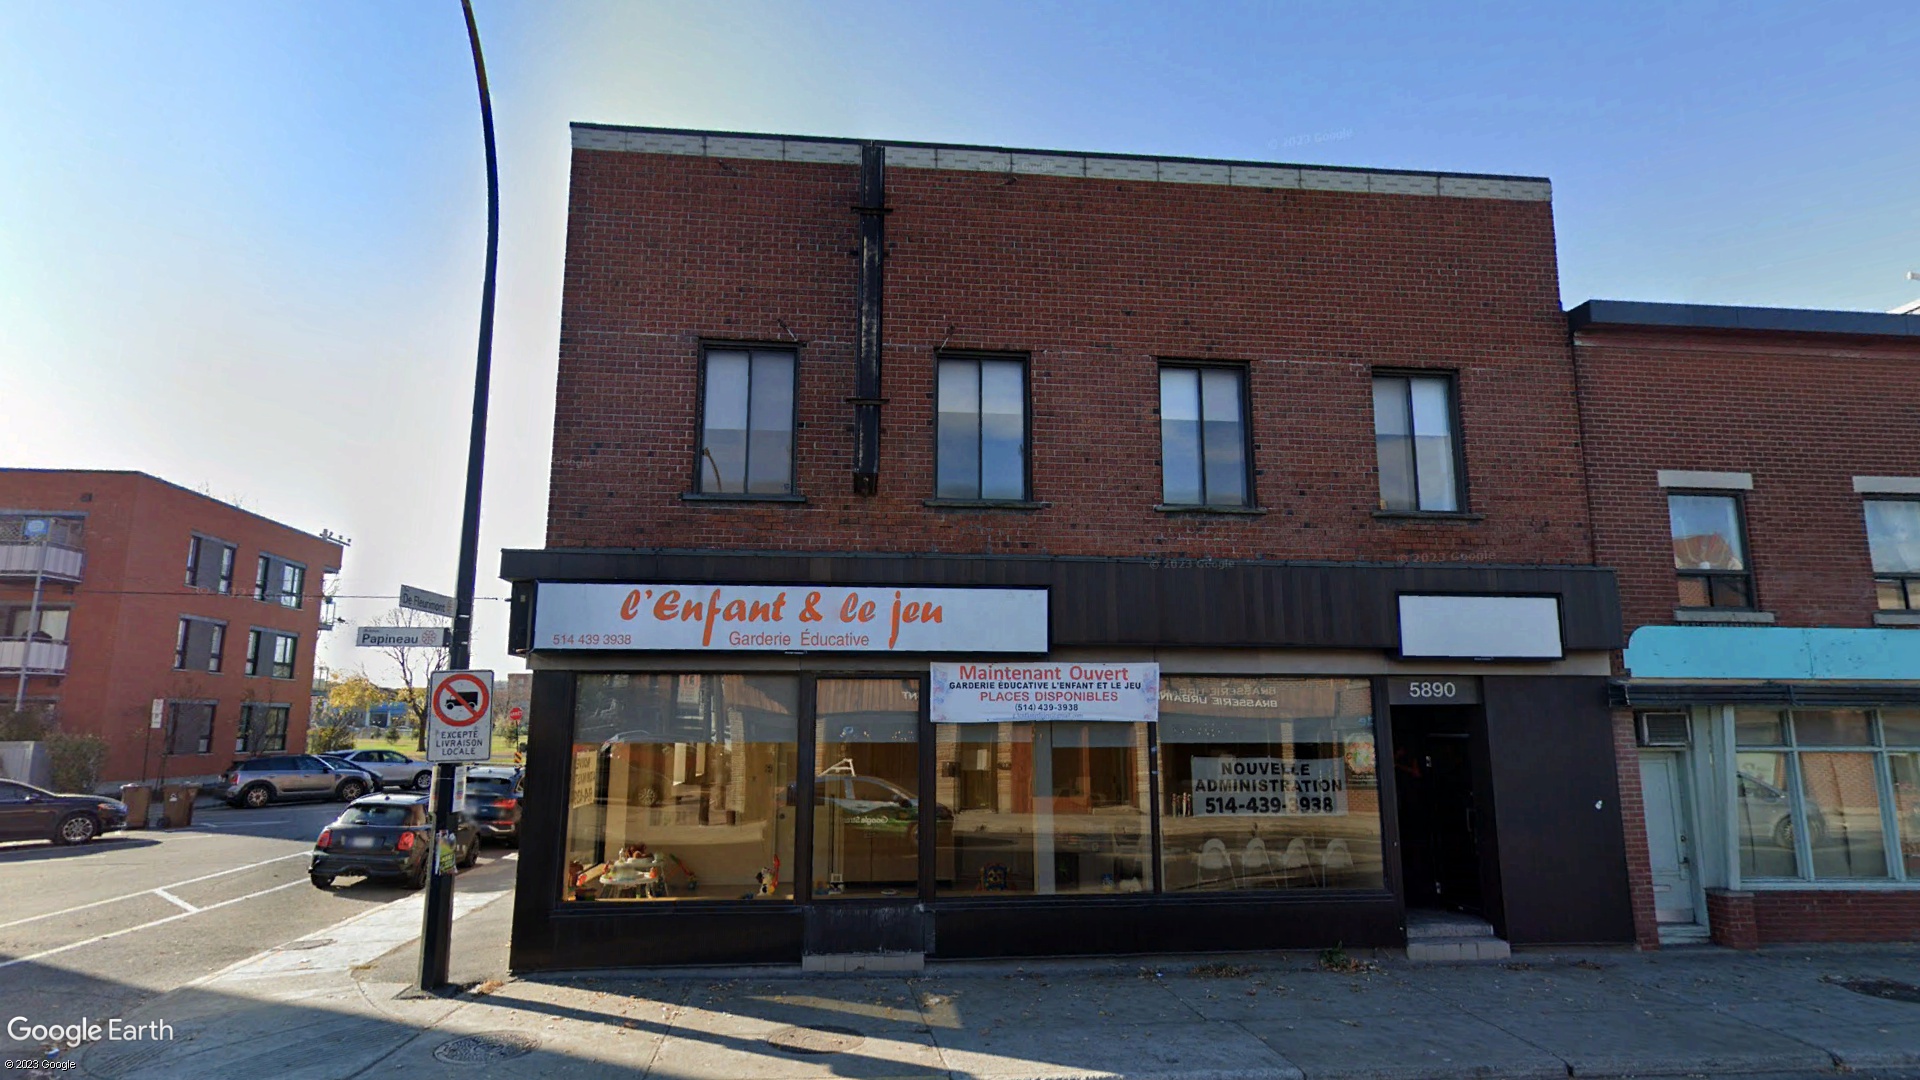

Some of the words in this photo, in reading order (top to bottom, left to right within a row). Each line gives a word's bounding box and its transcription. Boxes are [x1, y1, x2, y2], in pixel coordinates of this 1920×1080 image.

[402, 593, 412, 605] De
[798, 591, 823, 622] &
[839, 592, 876, 623] le
[888, 589, 943, 650] jeu
[361, 633, 419, 646] Papineau
[552, 634, 574, 645] 514
[578, 634, 600, 645] 439
[603, 634, 632, 645] 3938
[729, 630, 791, 647] Garderie
[800, 628, 870, 647] Éducative
[959, 664, 1061, 681] Maintenant
[1069, 665, 1129, 681] Ouvert
[949, 681, 995, 690] GARDERIE
[1052, 681, 1093, 690] L'ENFANT
[1097, 681, 1108, 690] ET
[1111, 681, 1121, 690] LE
[1124, 681, 1141, 690] JEU
[1409, 681, 1456, 698] 5890
[980, 691, 1030, 702] PLACES
[1034, 691, 1118, 702] DISPONIBLES
[1014, 702, 1037, 712] (514)
[1038, 702, 1079, 712] 439-3938
[435, 738, 483, 748] LIVRAISON
[441, 747, 476, 756] LOCALE
[1221, 762, 1311, 776] NOUVELLE
[1195, 778, 1343, 792] ADMINISTRATION
[1205, 796, 1334, 814] 514-439-3938
